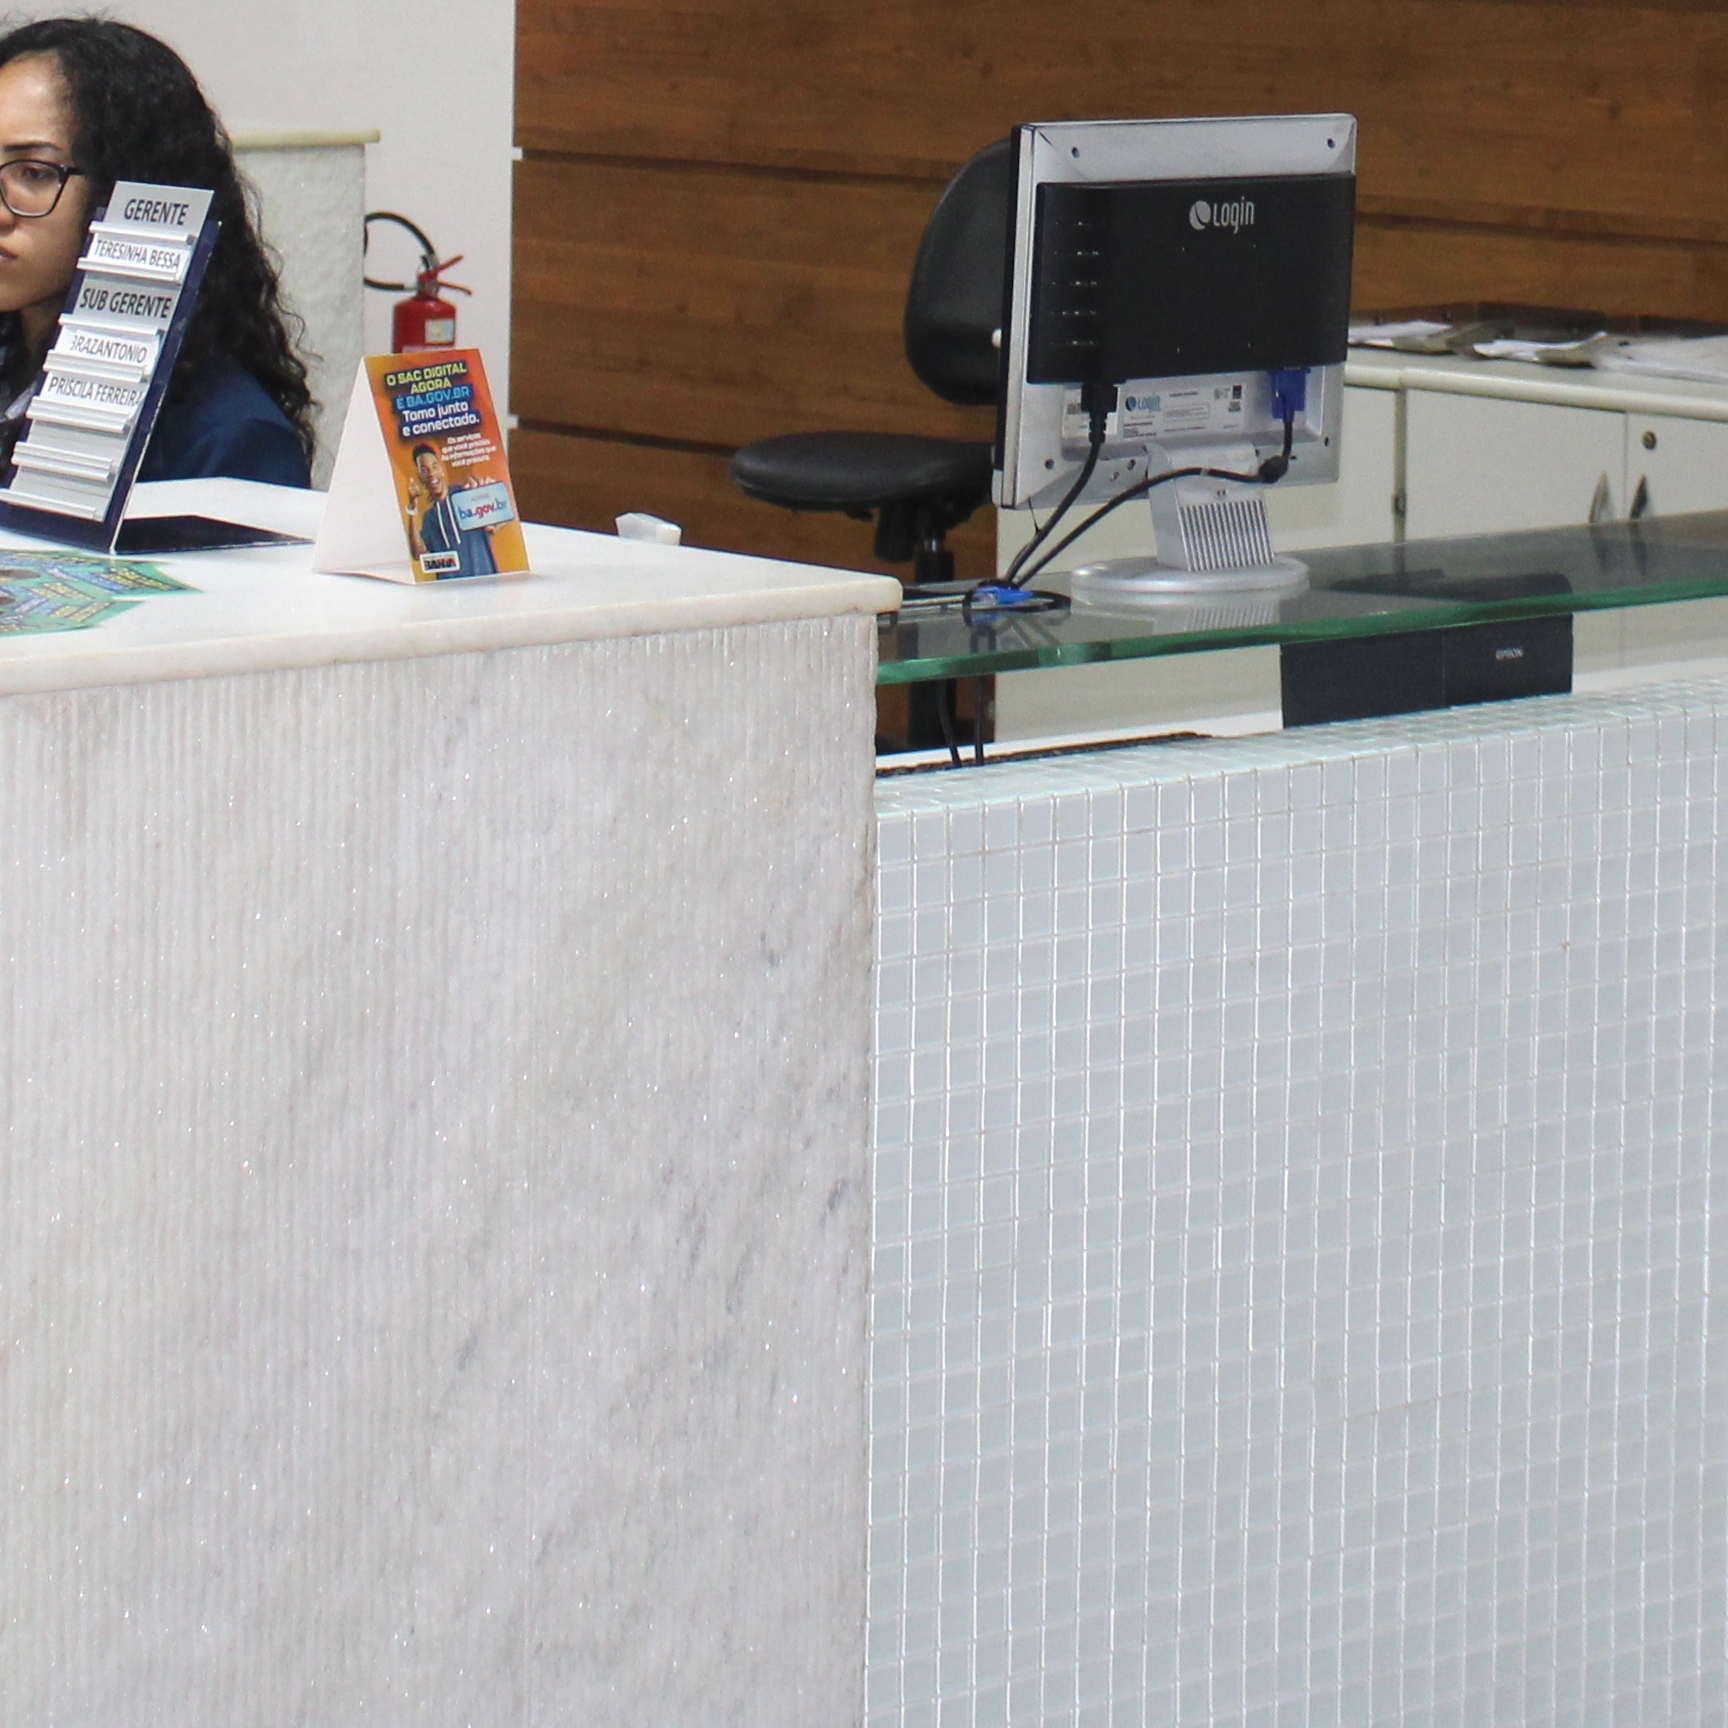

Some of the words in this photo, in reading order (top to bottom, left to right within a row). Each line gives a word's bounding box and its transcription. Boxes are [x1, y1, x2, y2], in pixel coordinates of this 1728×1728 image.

[124, 198, 189, 226] GERENTE
[94, 239, 148, 264] TERESINHA
[149, 247, 181, 270] BESSA
[79, 287, 107, 312] SUB
[109, 291, 172, 319] GERENTE
[386, 375, 396, 387] O
[398, 369, 421, 385] SAC
[423, 362, 467, 380] DIGITAL
[410, 378, 452, 394] AGORA
[48, 376, 94, 399] PRISCILA
[396, 394, 403, 409] É
[405, 385, 470, 407] BA.GOV.BR
[402, 406, 435, 422] Tamo
[437, 401, 468, 420] junto
[402, 427, 410, 437] e
[412, 413, 480, 434] conectado.
